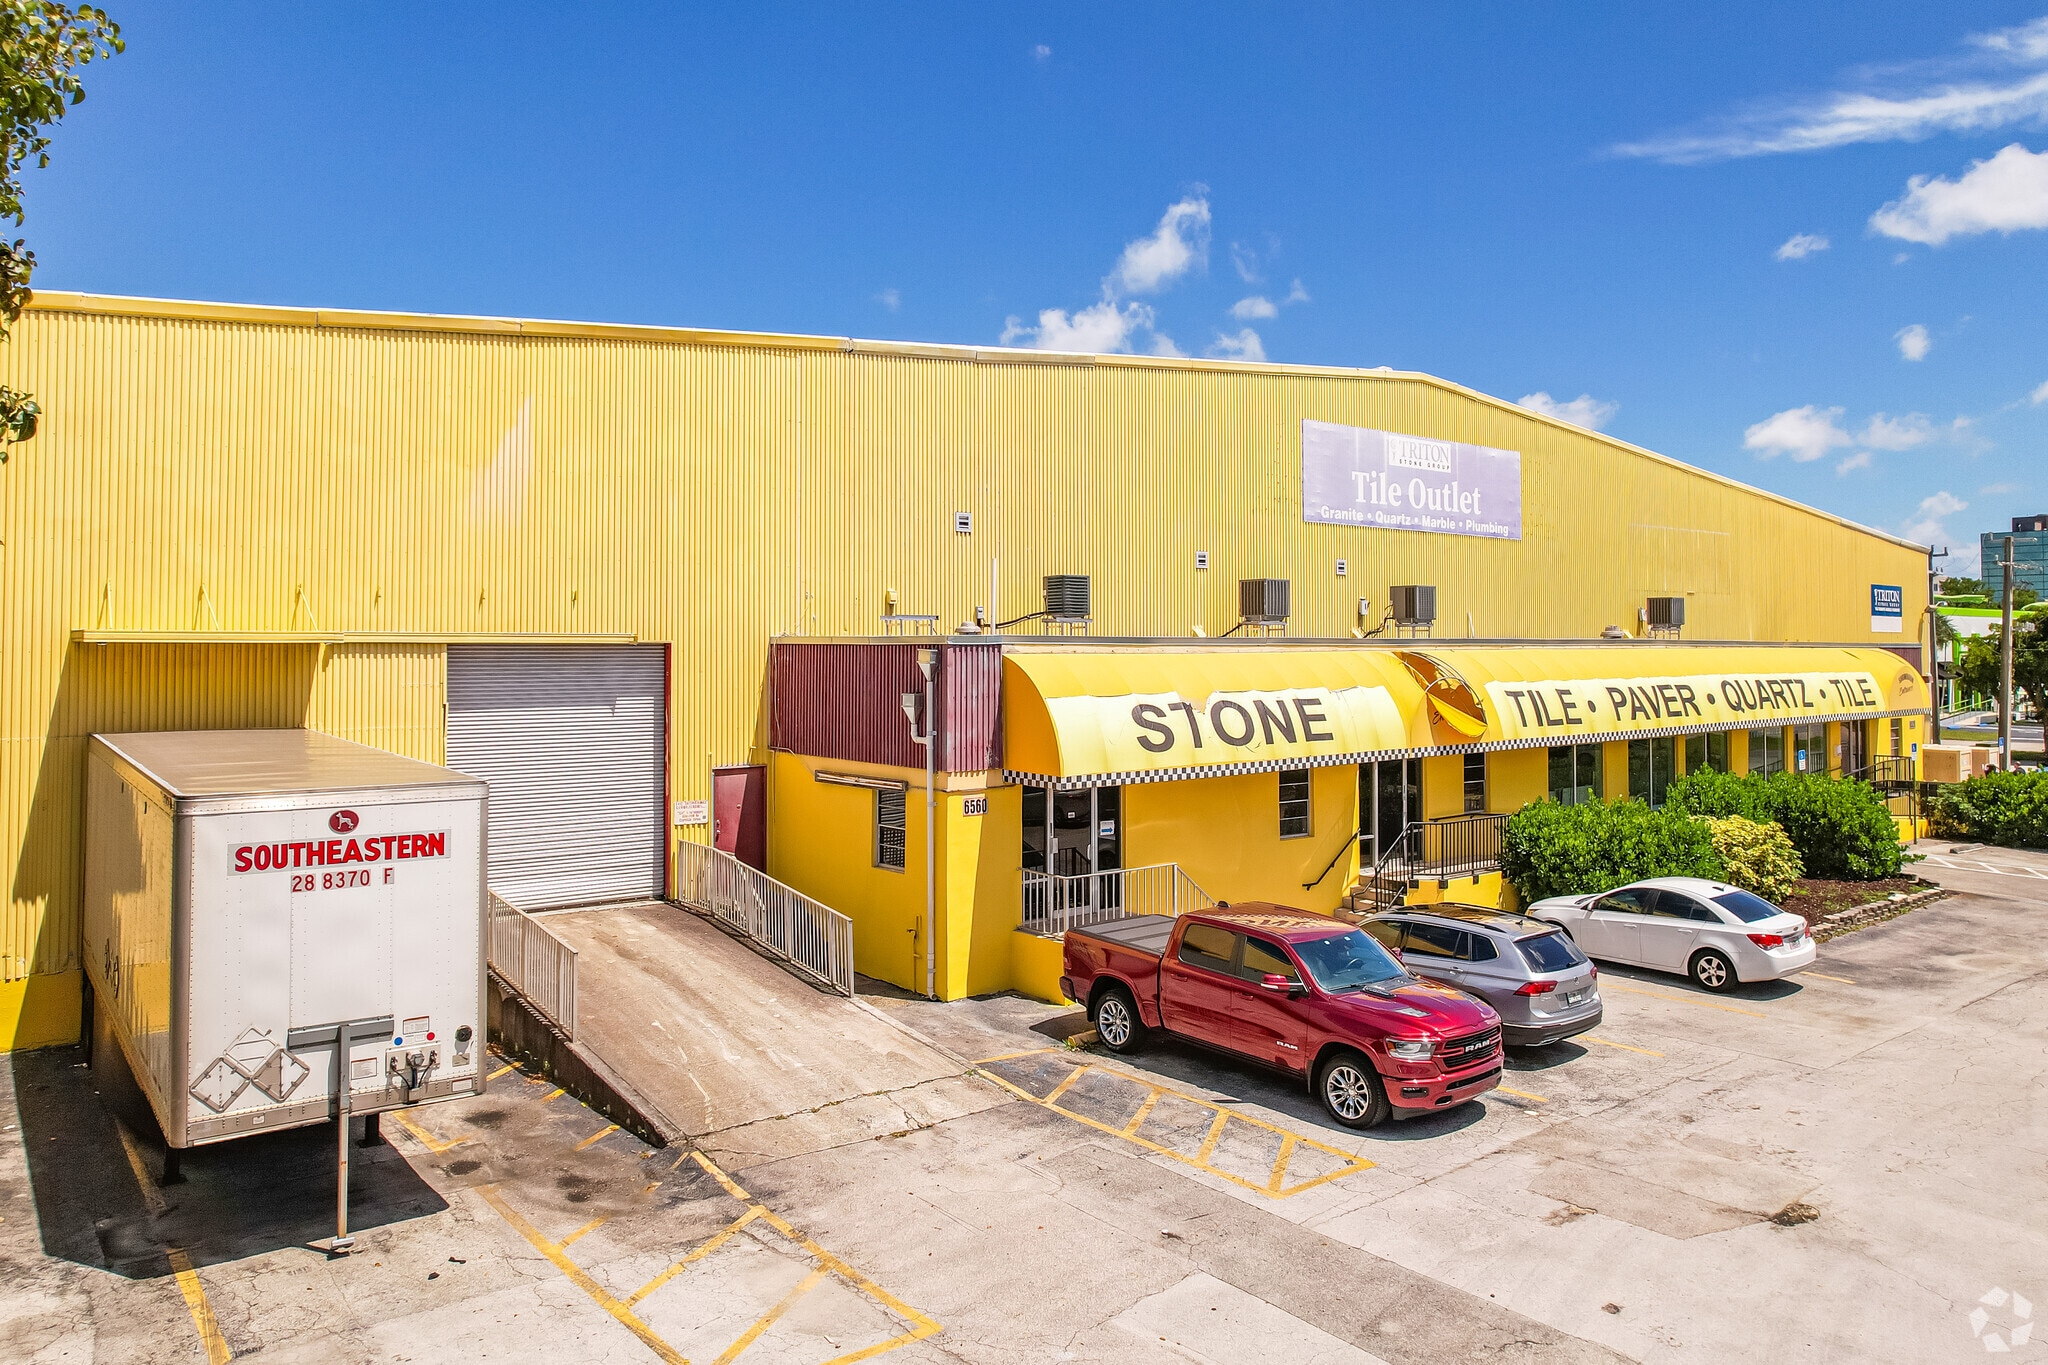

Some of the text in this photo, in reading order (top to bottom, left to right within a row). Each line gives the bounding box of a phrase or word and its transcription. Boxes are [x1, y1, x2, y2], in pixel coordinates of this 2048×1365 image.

[1399, 440, 1449, 463] TRITON
[1399, 458, 1450, 470] STONE GROUP
[1352, 470, 1482, 516] Tile Outlet
[1320, 505, 1509, 537] Granite Quartz Marble Plumbing
[1876, 589, 1900, 602] TRITON
[1505, 678, 1877, 728] TILE PAVER QUARTZ TILE
[1131, 697, 1334, 753] STONE
[964, 798, 987, 815] 6560
[234, 832, 445, 873] SOUTHEASTERN
[292, 867, 393, 893] 28 8370 F
[1465, 1039, 1490, 1053] RAM
